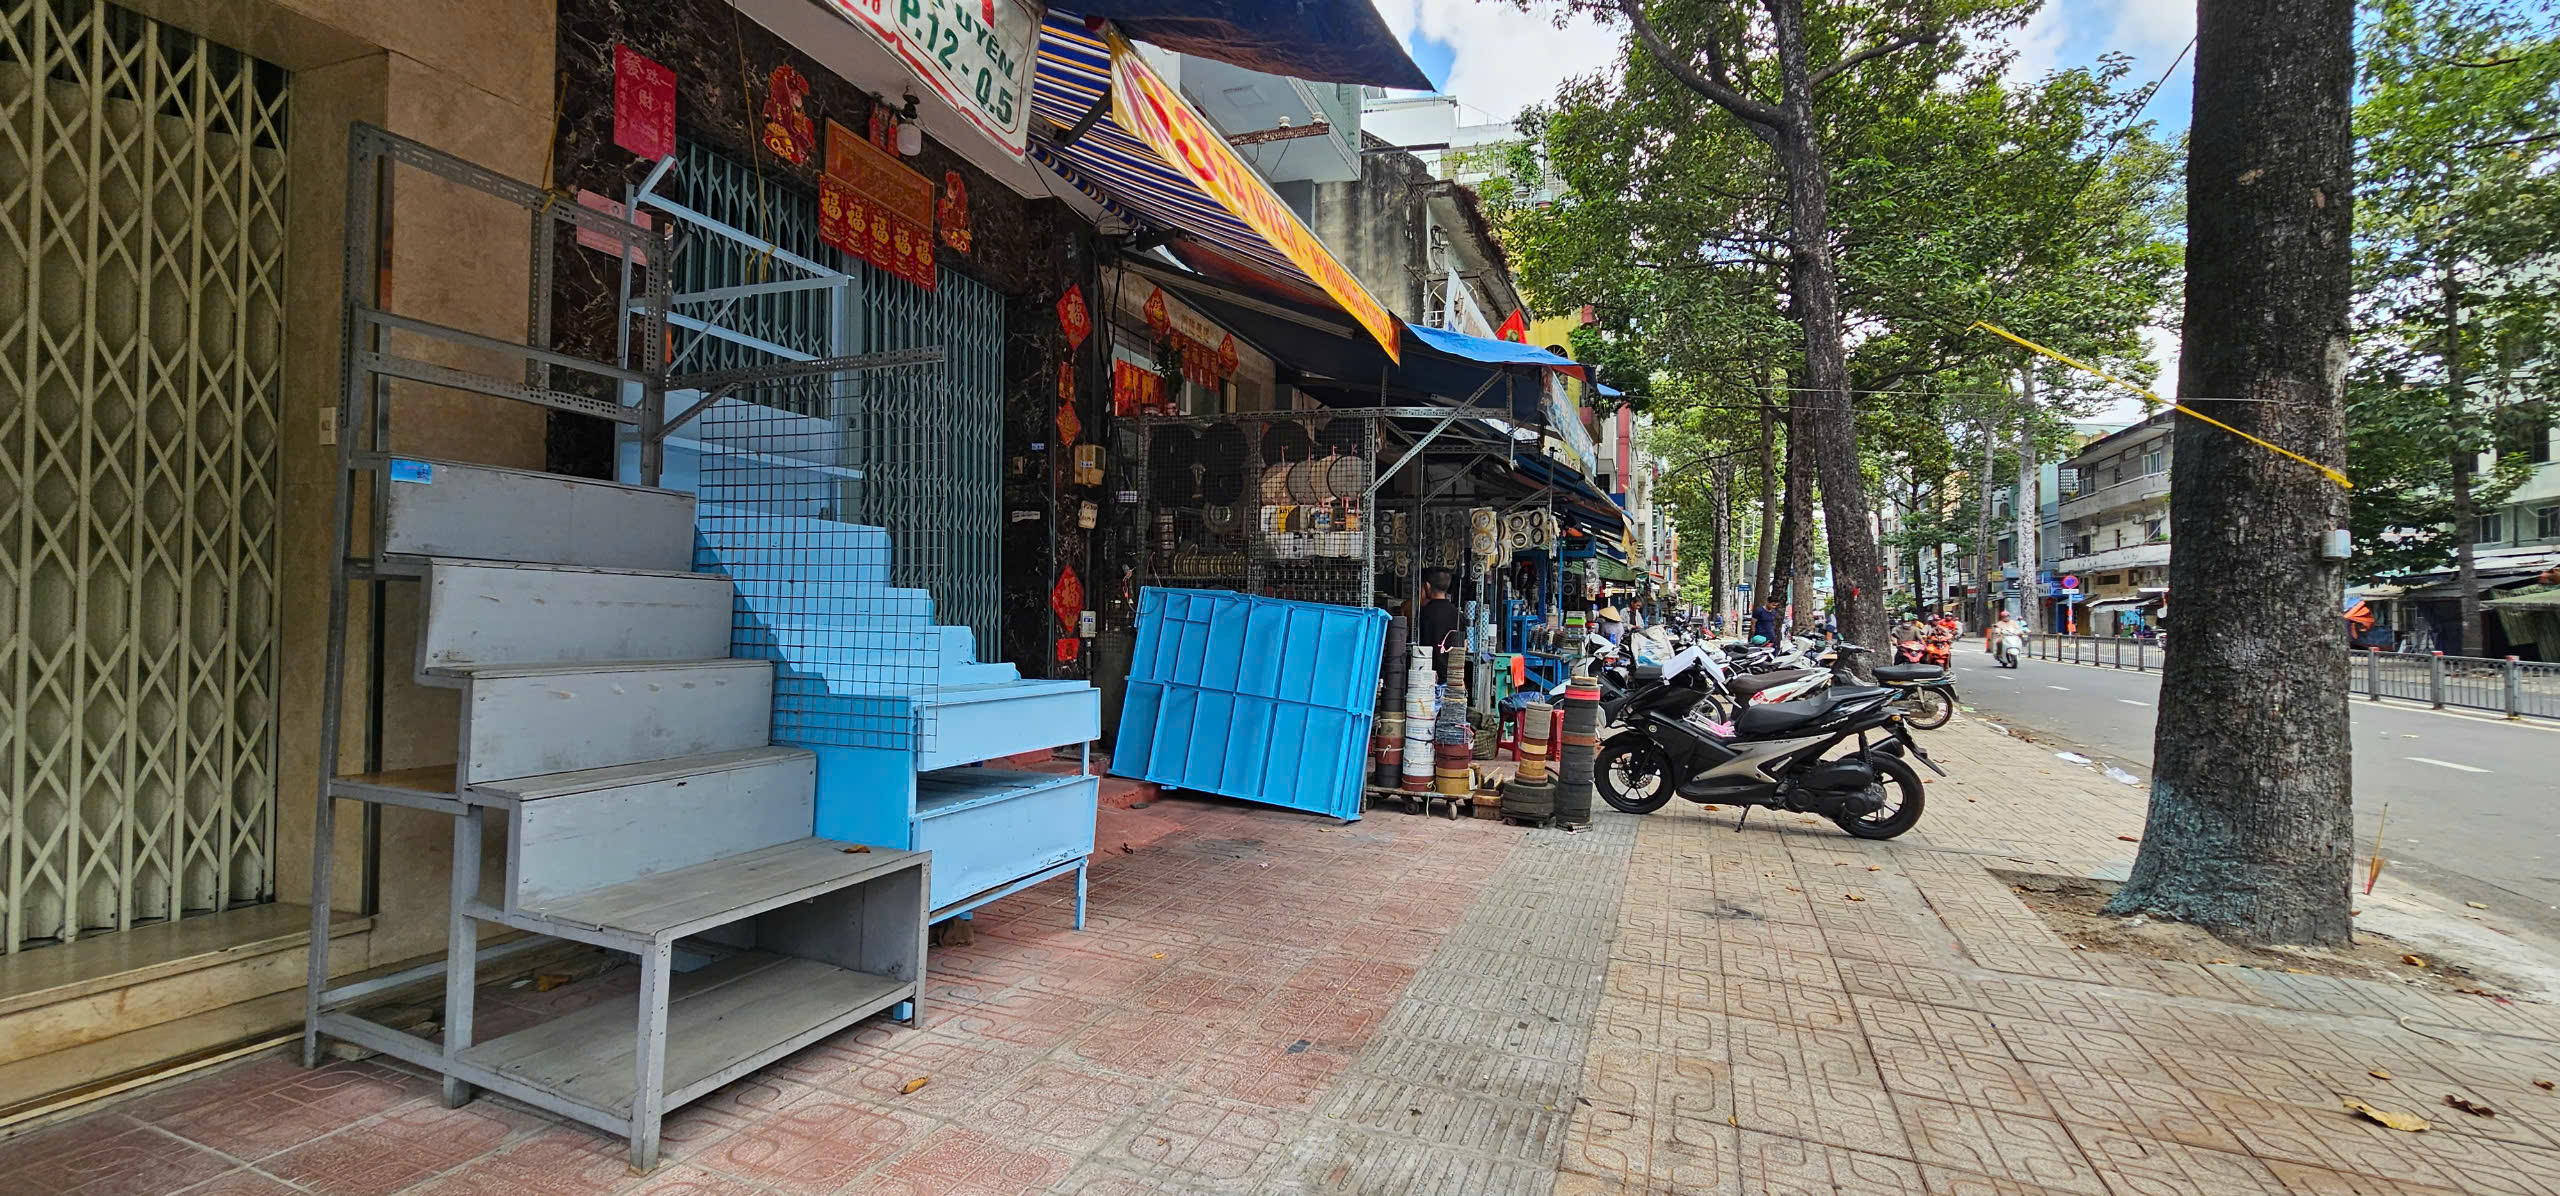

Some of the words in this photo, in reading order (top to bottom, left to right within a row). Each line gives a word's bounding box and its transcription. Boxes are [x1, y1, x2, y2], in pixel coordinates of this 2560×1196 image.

[899, 0, 959, 71] P.12
[975, 66, 1014, 125] Q.5
[956, 3, 1014, 80] UYÊN
